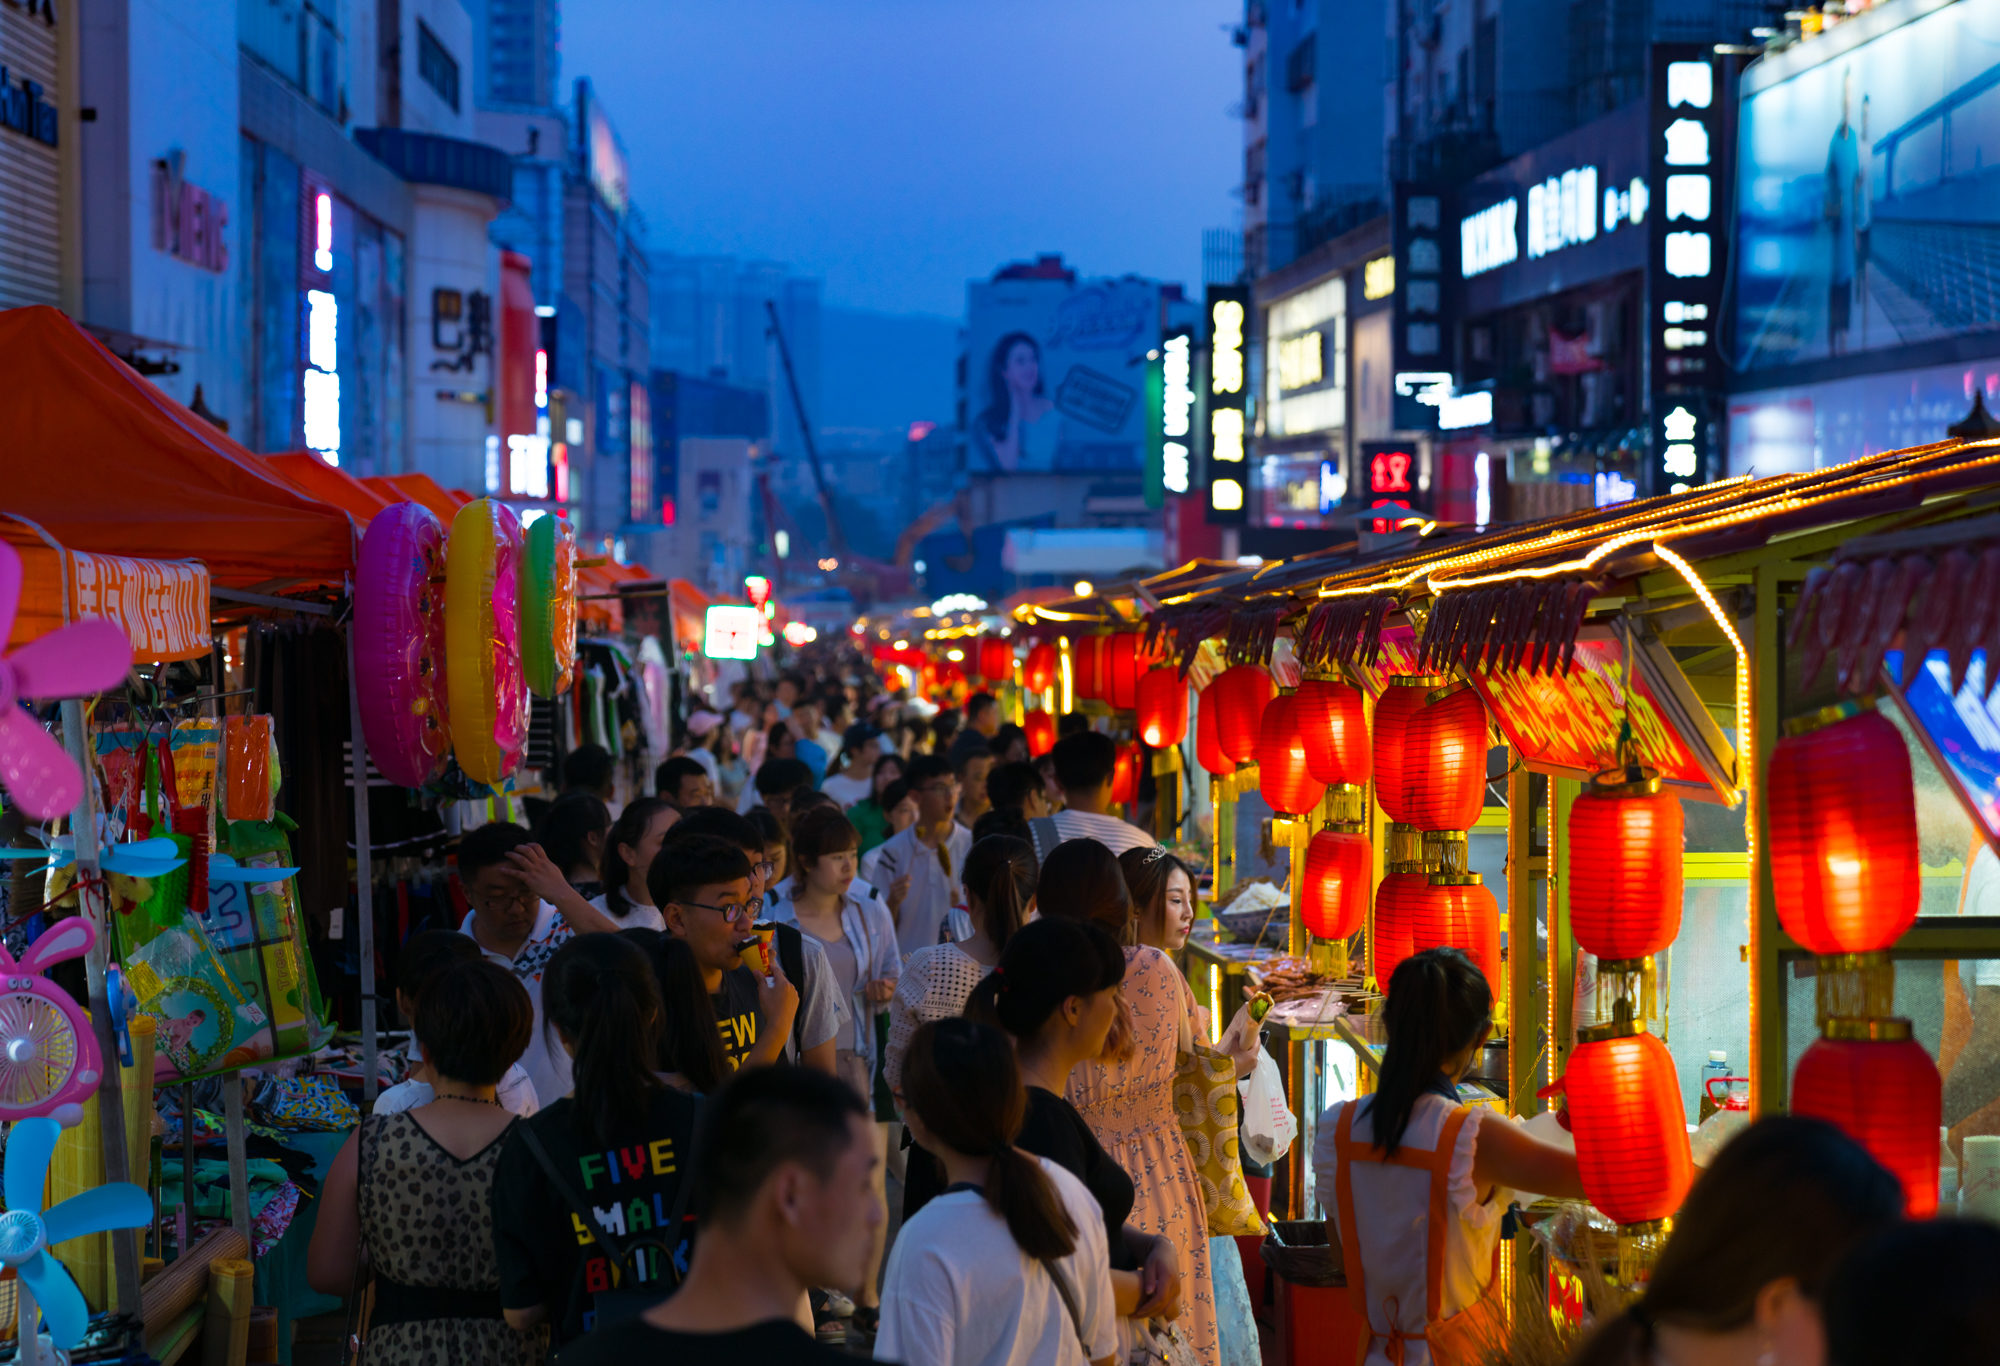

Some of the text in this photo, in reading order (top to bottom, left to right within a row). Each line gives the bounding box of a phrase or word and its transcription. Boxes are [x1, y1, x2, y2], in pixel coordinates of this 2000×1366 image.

[716, 1011, 756, 1051] EW
[579, 1138, 677, 1190] FIVE
[571, 1192, 697, 1246] SMAL
